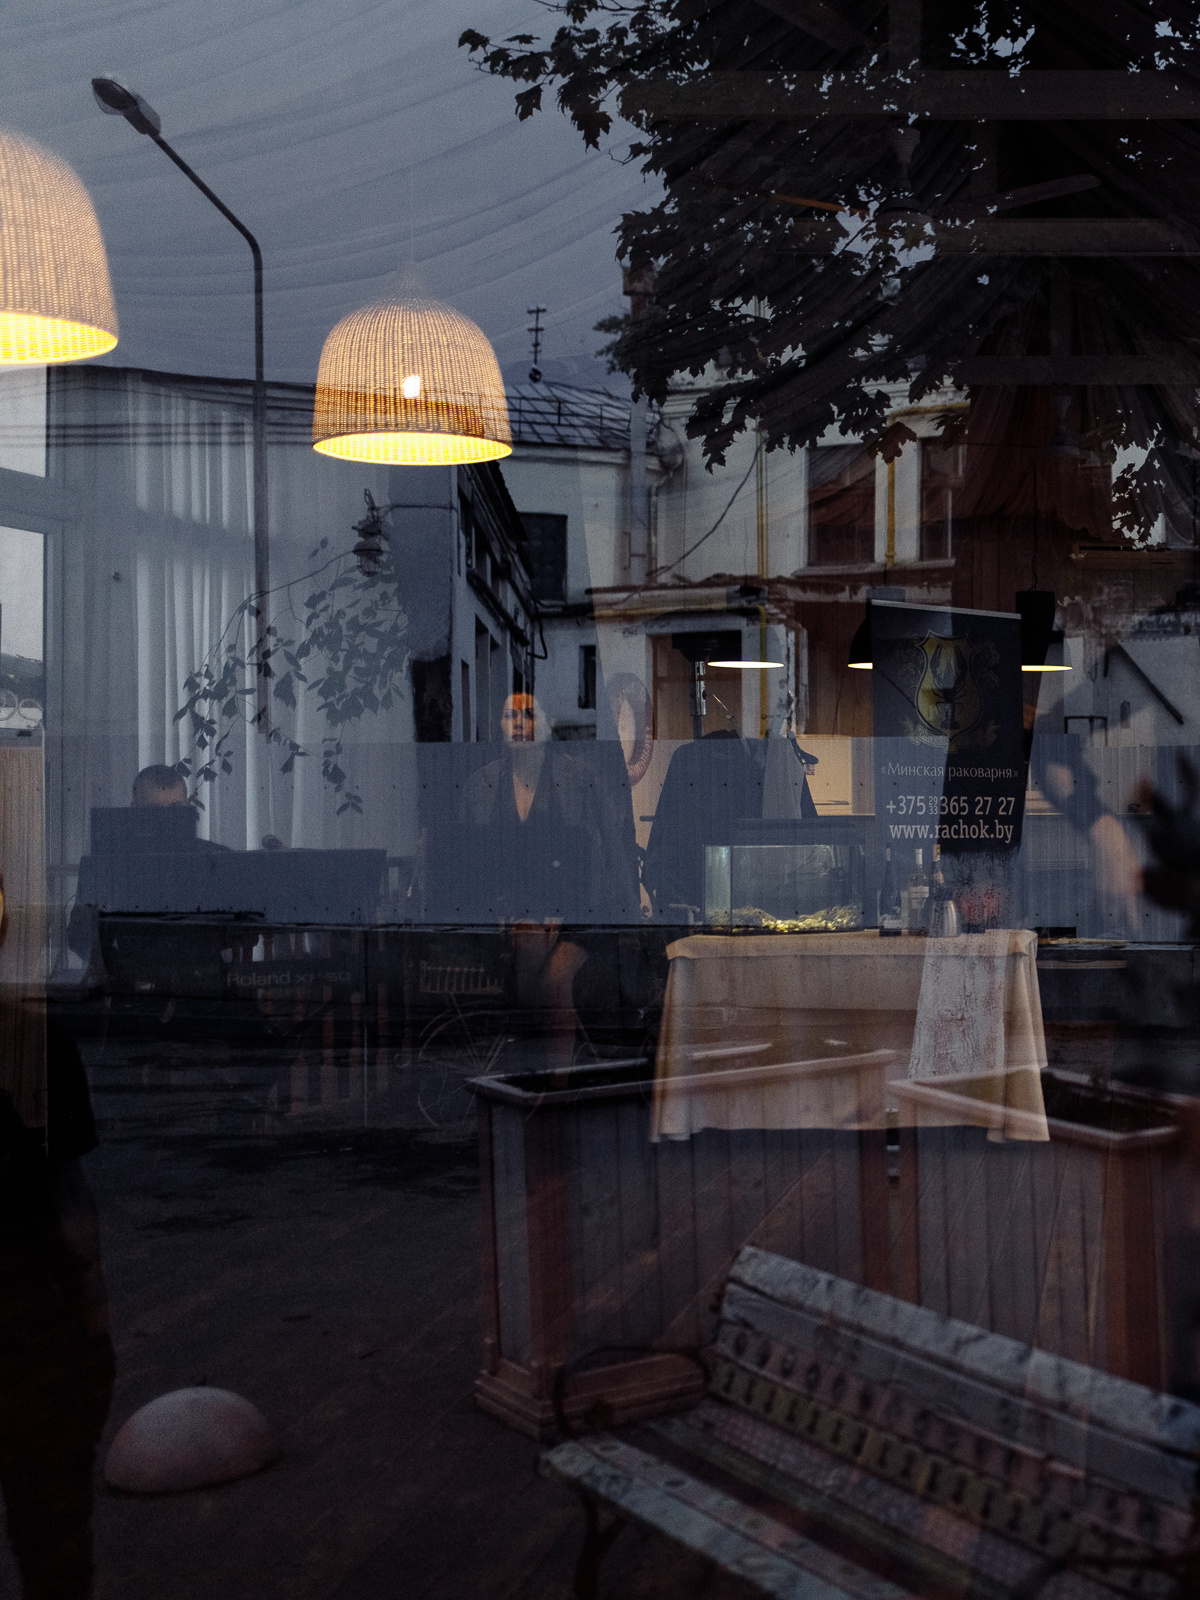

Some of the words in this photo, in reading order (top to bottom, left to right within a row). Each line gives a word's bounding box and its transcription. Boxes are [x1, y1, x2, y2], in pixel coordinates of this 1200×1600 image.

[880, 761, 945, 777] «Минская
[948, 766, 1019, 783] раковарня»
[886, 795, 926, 815] +375
[939, 796, 969, 815] 365
[974, 796, 993, 816] 27
[998, 796, 1016, 816] 27
[888, 819, 1014, 844] www.rachok.by
[226, 970, 291, 987] Roland
